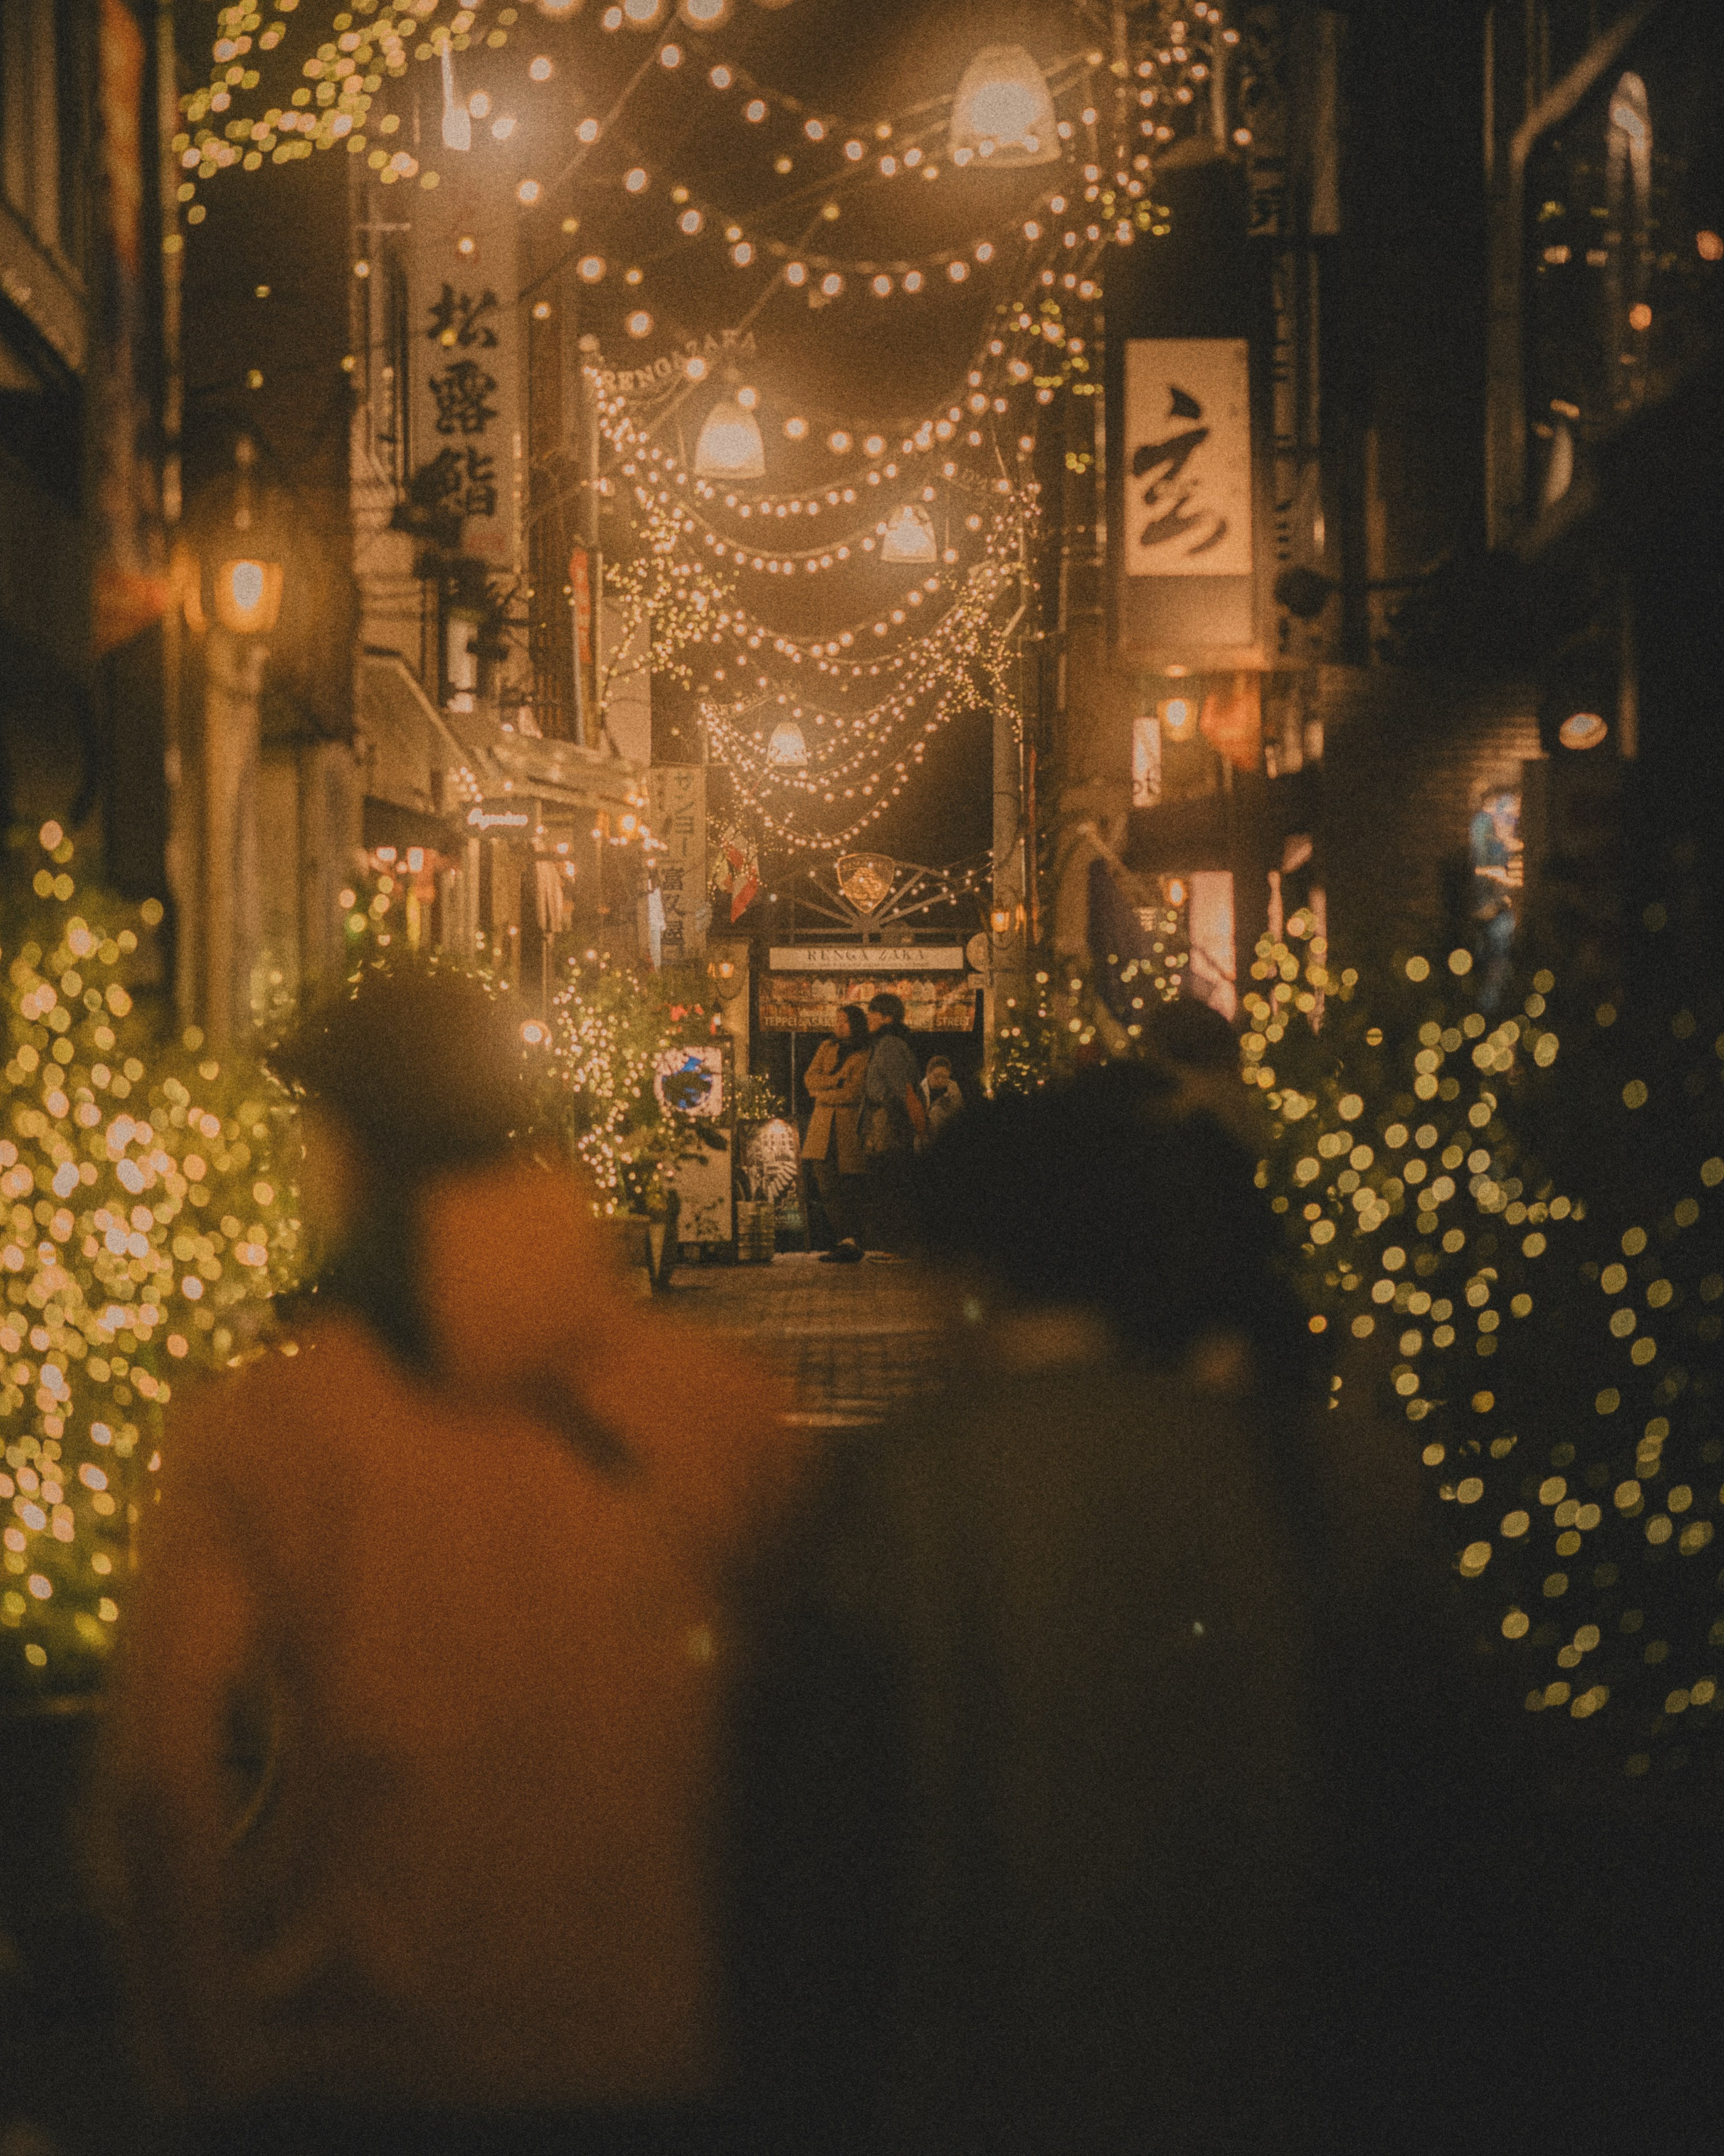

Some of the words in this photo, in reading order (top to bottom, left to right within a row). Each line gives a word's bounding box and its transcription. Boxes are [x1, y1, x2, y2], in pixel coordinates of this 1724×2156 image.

[807, 949, 868, 961] RENGA
[879, 949, 924, 960] ZAKA
[937, 1016, 970, 1026] STREET
